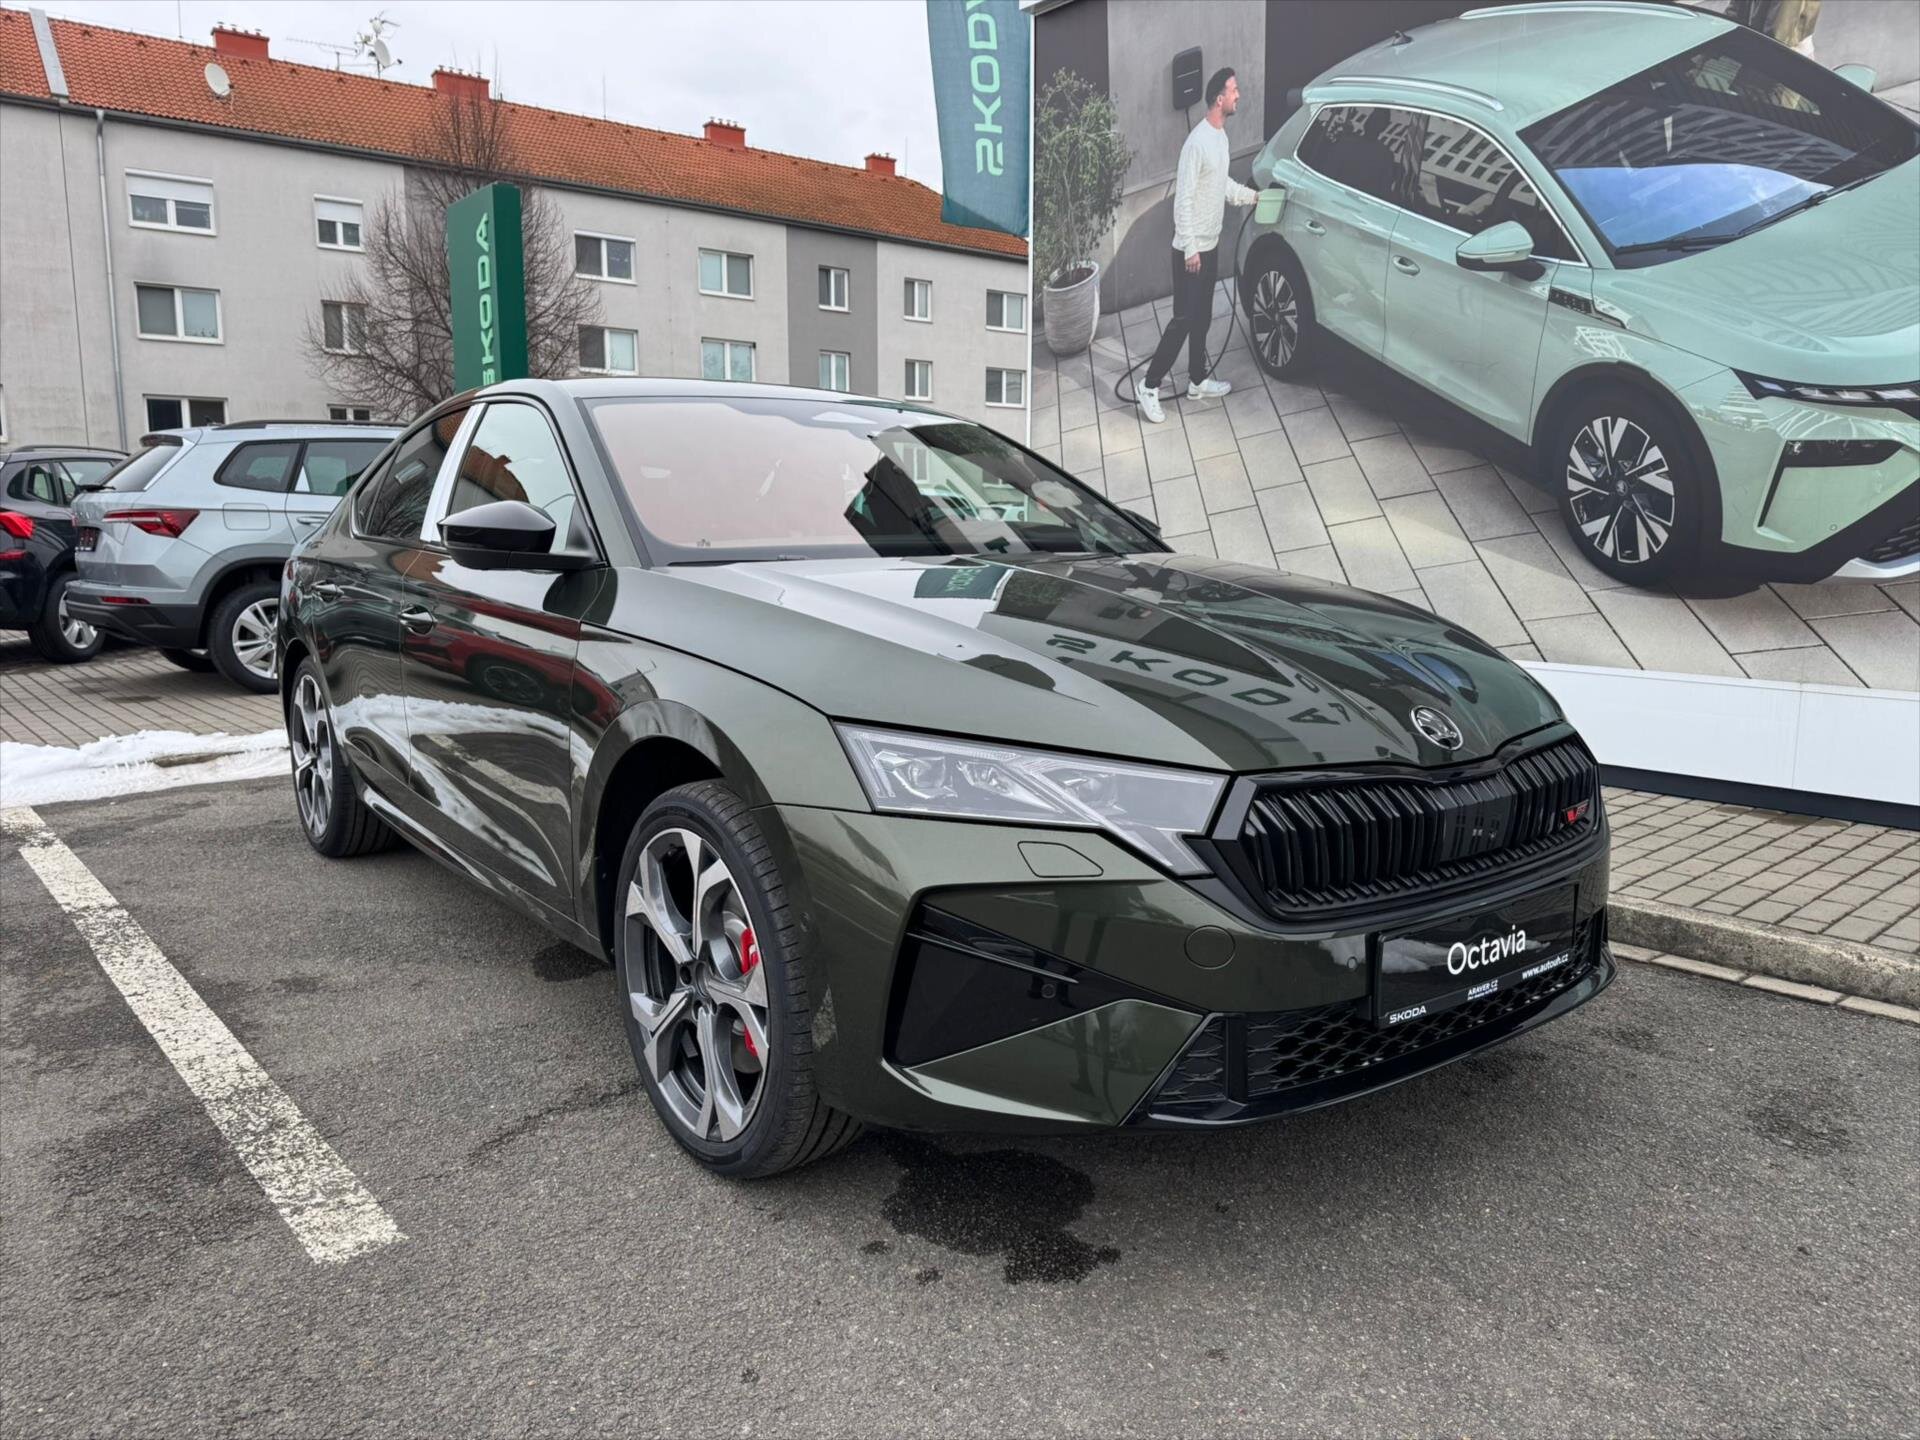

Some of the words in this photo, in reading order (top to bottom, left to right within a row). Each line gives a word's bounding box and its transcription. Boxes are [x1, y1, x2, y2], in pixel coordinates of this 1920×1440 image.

[966, 0, 1004, 176] SKOD
[1447, 924, 1527, 975] Octavia
[1389, 1005, 1427, 1024] SKODA
